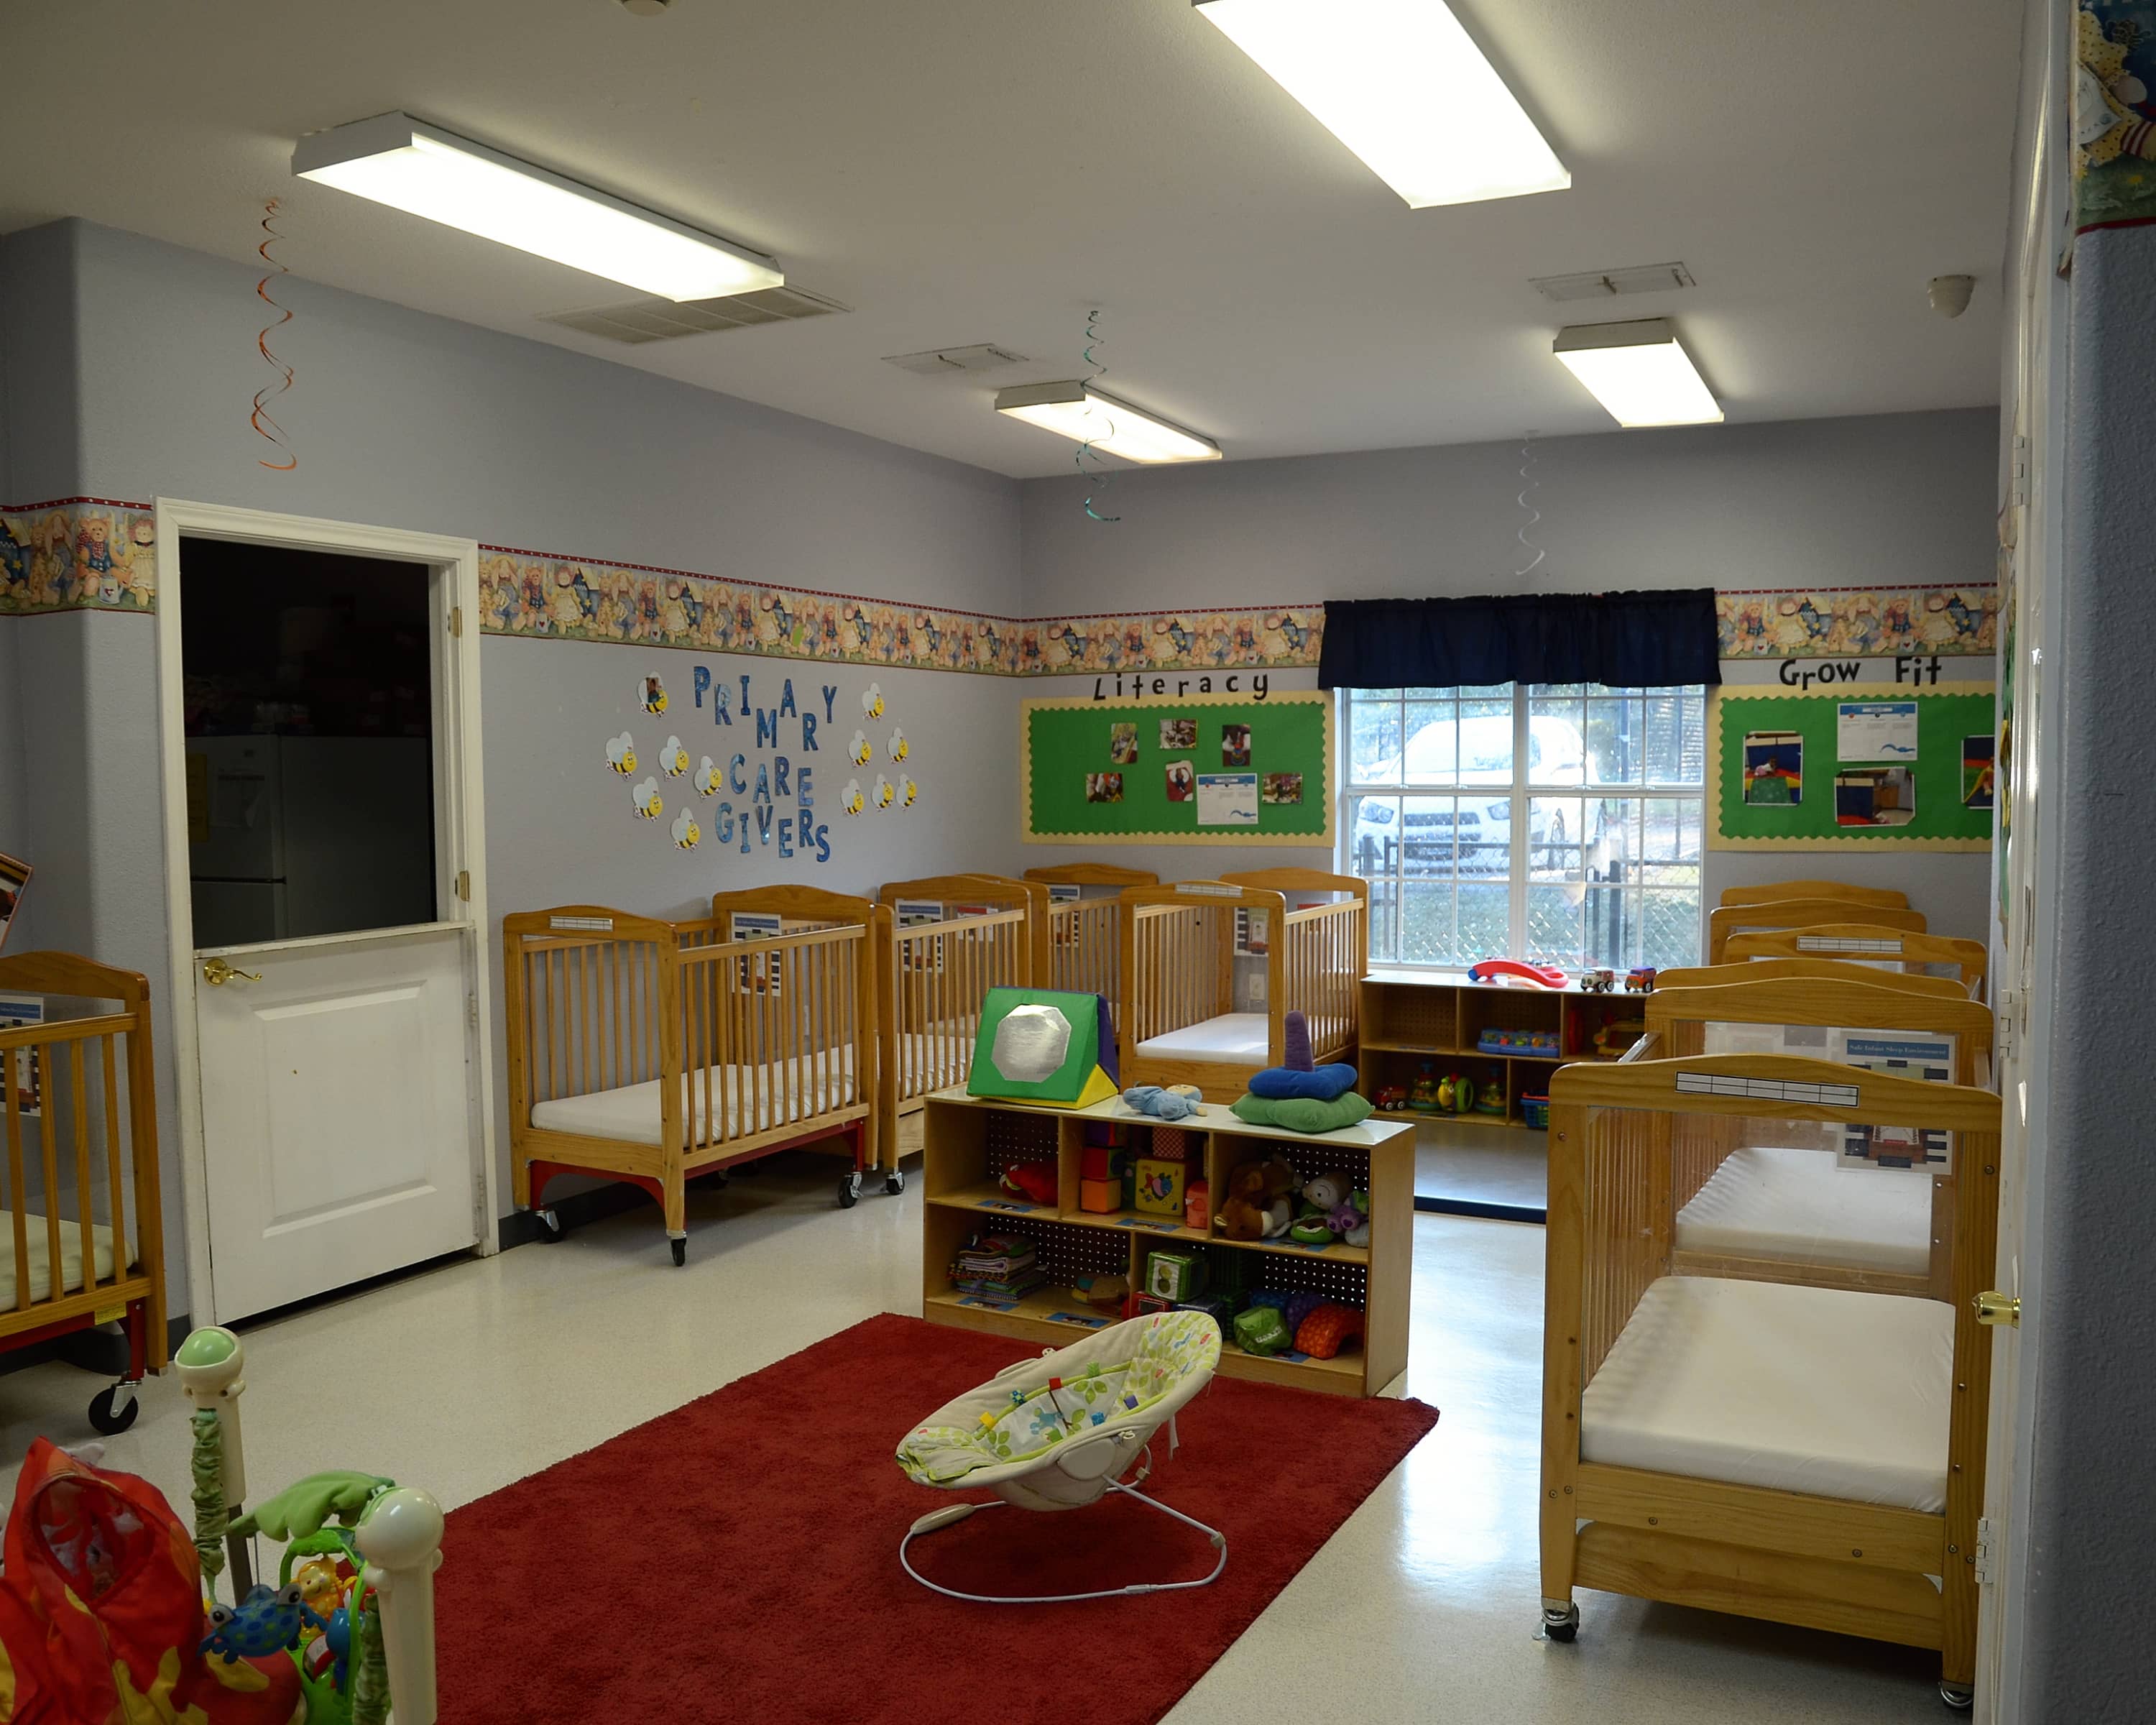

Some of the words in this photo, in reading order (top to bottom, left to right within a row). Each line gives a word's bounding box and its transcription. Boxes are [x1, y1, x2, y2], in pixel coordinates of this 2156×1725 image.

[1093, 672, 1268, 701] Literacy
[1779, 658, 1861, 691] Grow
[1895, 655, 1943, 686] Fit
[694, 666, 837, 751] PRIMARY
[729, 753, 814, 806] CARE
[714, 802, 830, 862] GIVERS
